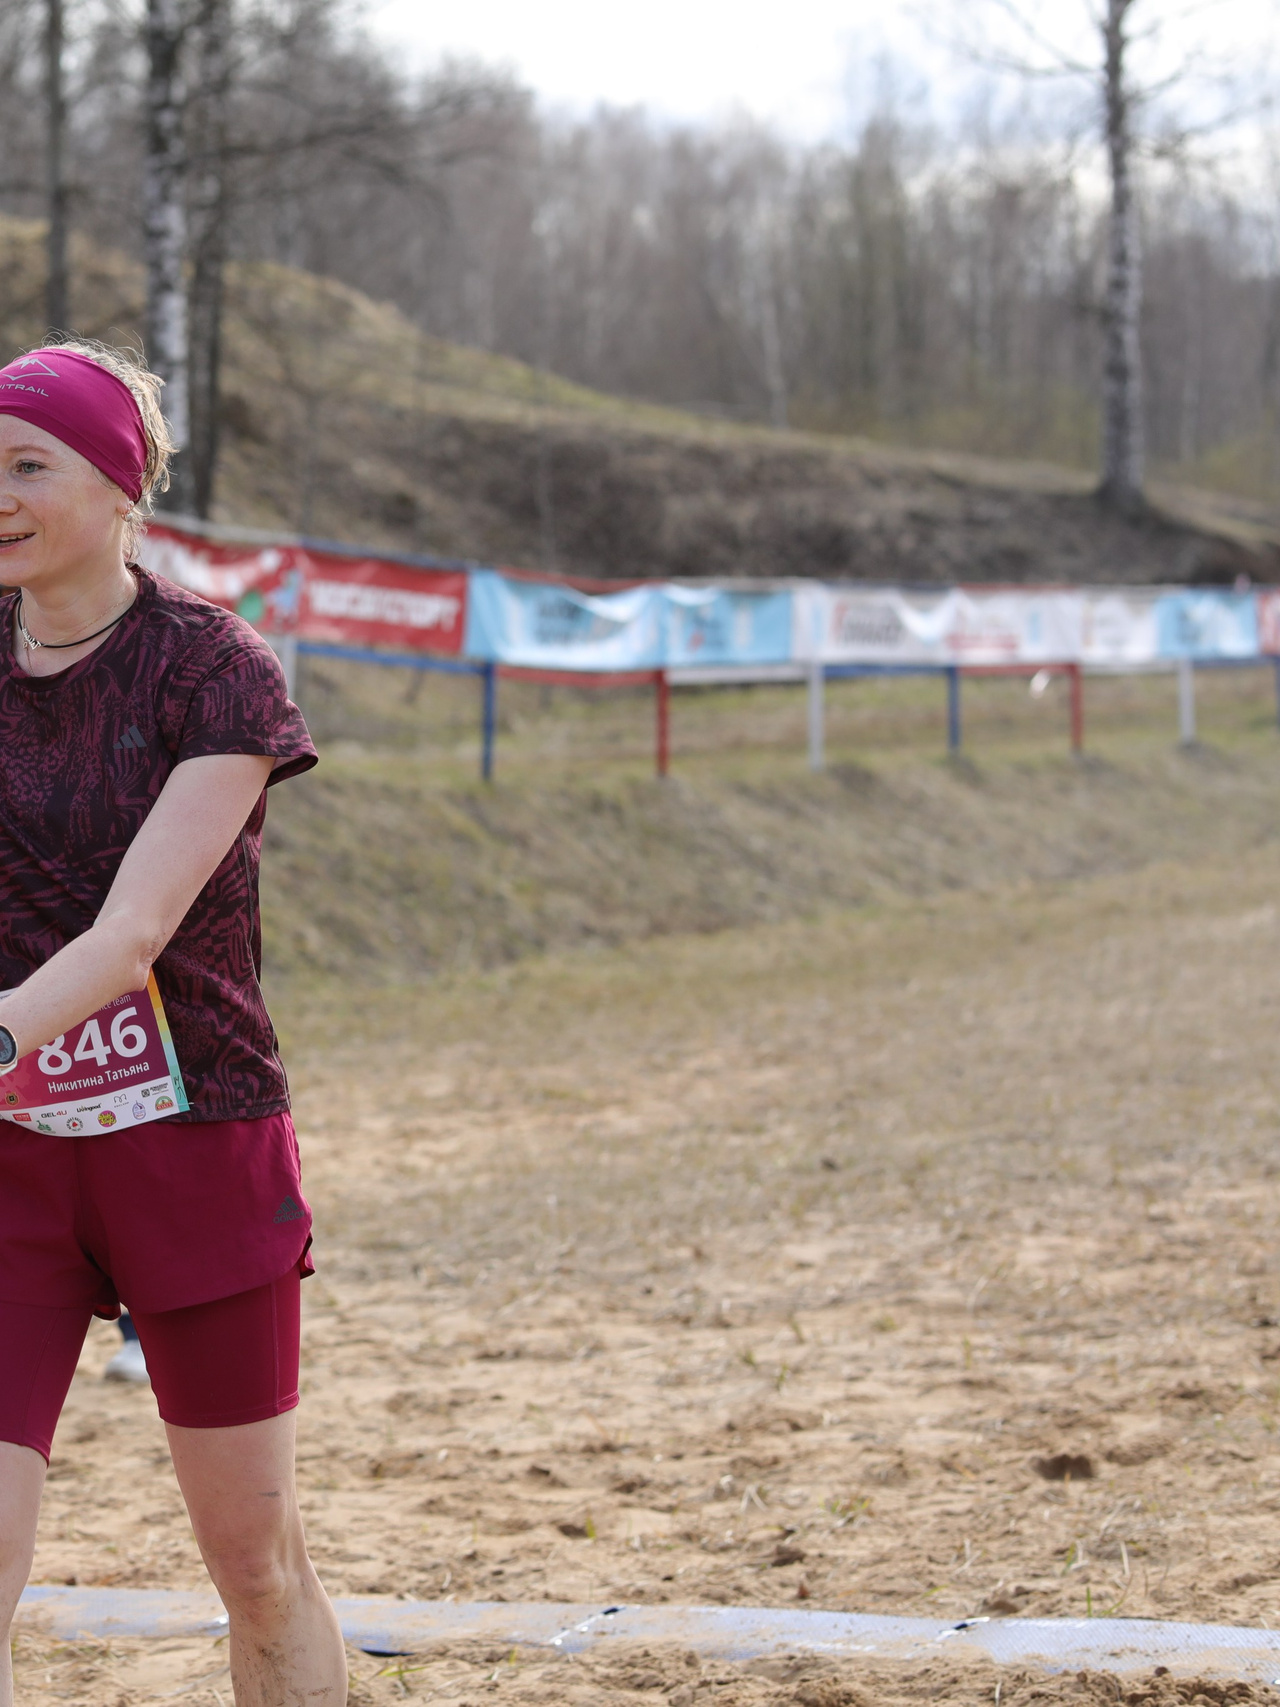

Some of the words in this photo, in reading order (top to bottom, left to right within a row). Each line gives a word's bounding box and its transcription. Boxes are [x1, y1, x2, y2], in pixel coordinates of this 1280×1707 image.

[37, 1006, 147, 1076] 846
[47, 1074, 104, 1094] Никитина
[104, 1061, 151, 1083] Татьяна
[272, 1209, 305, 1225] adidas
